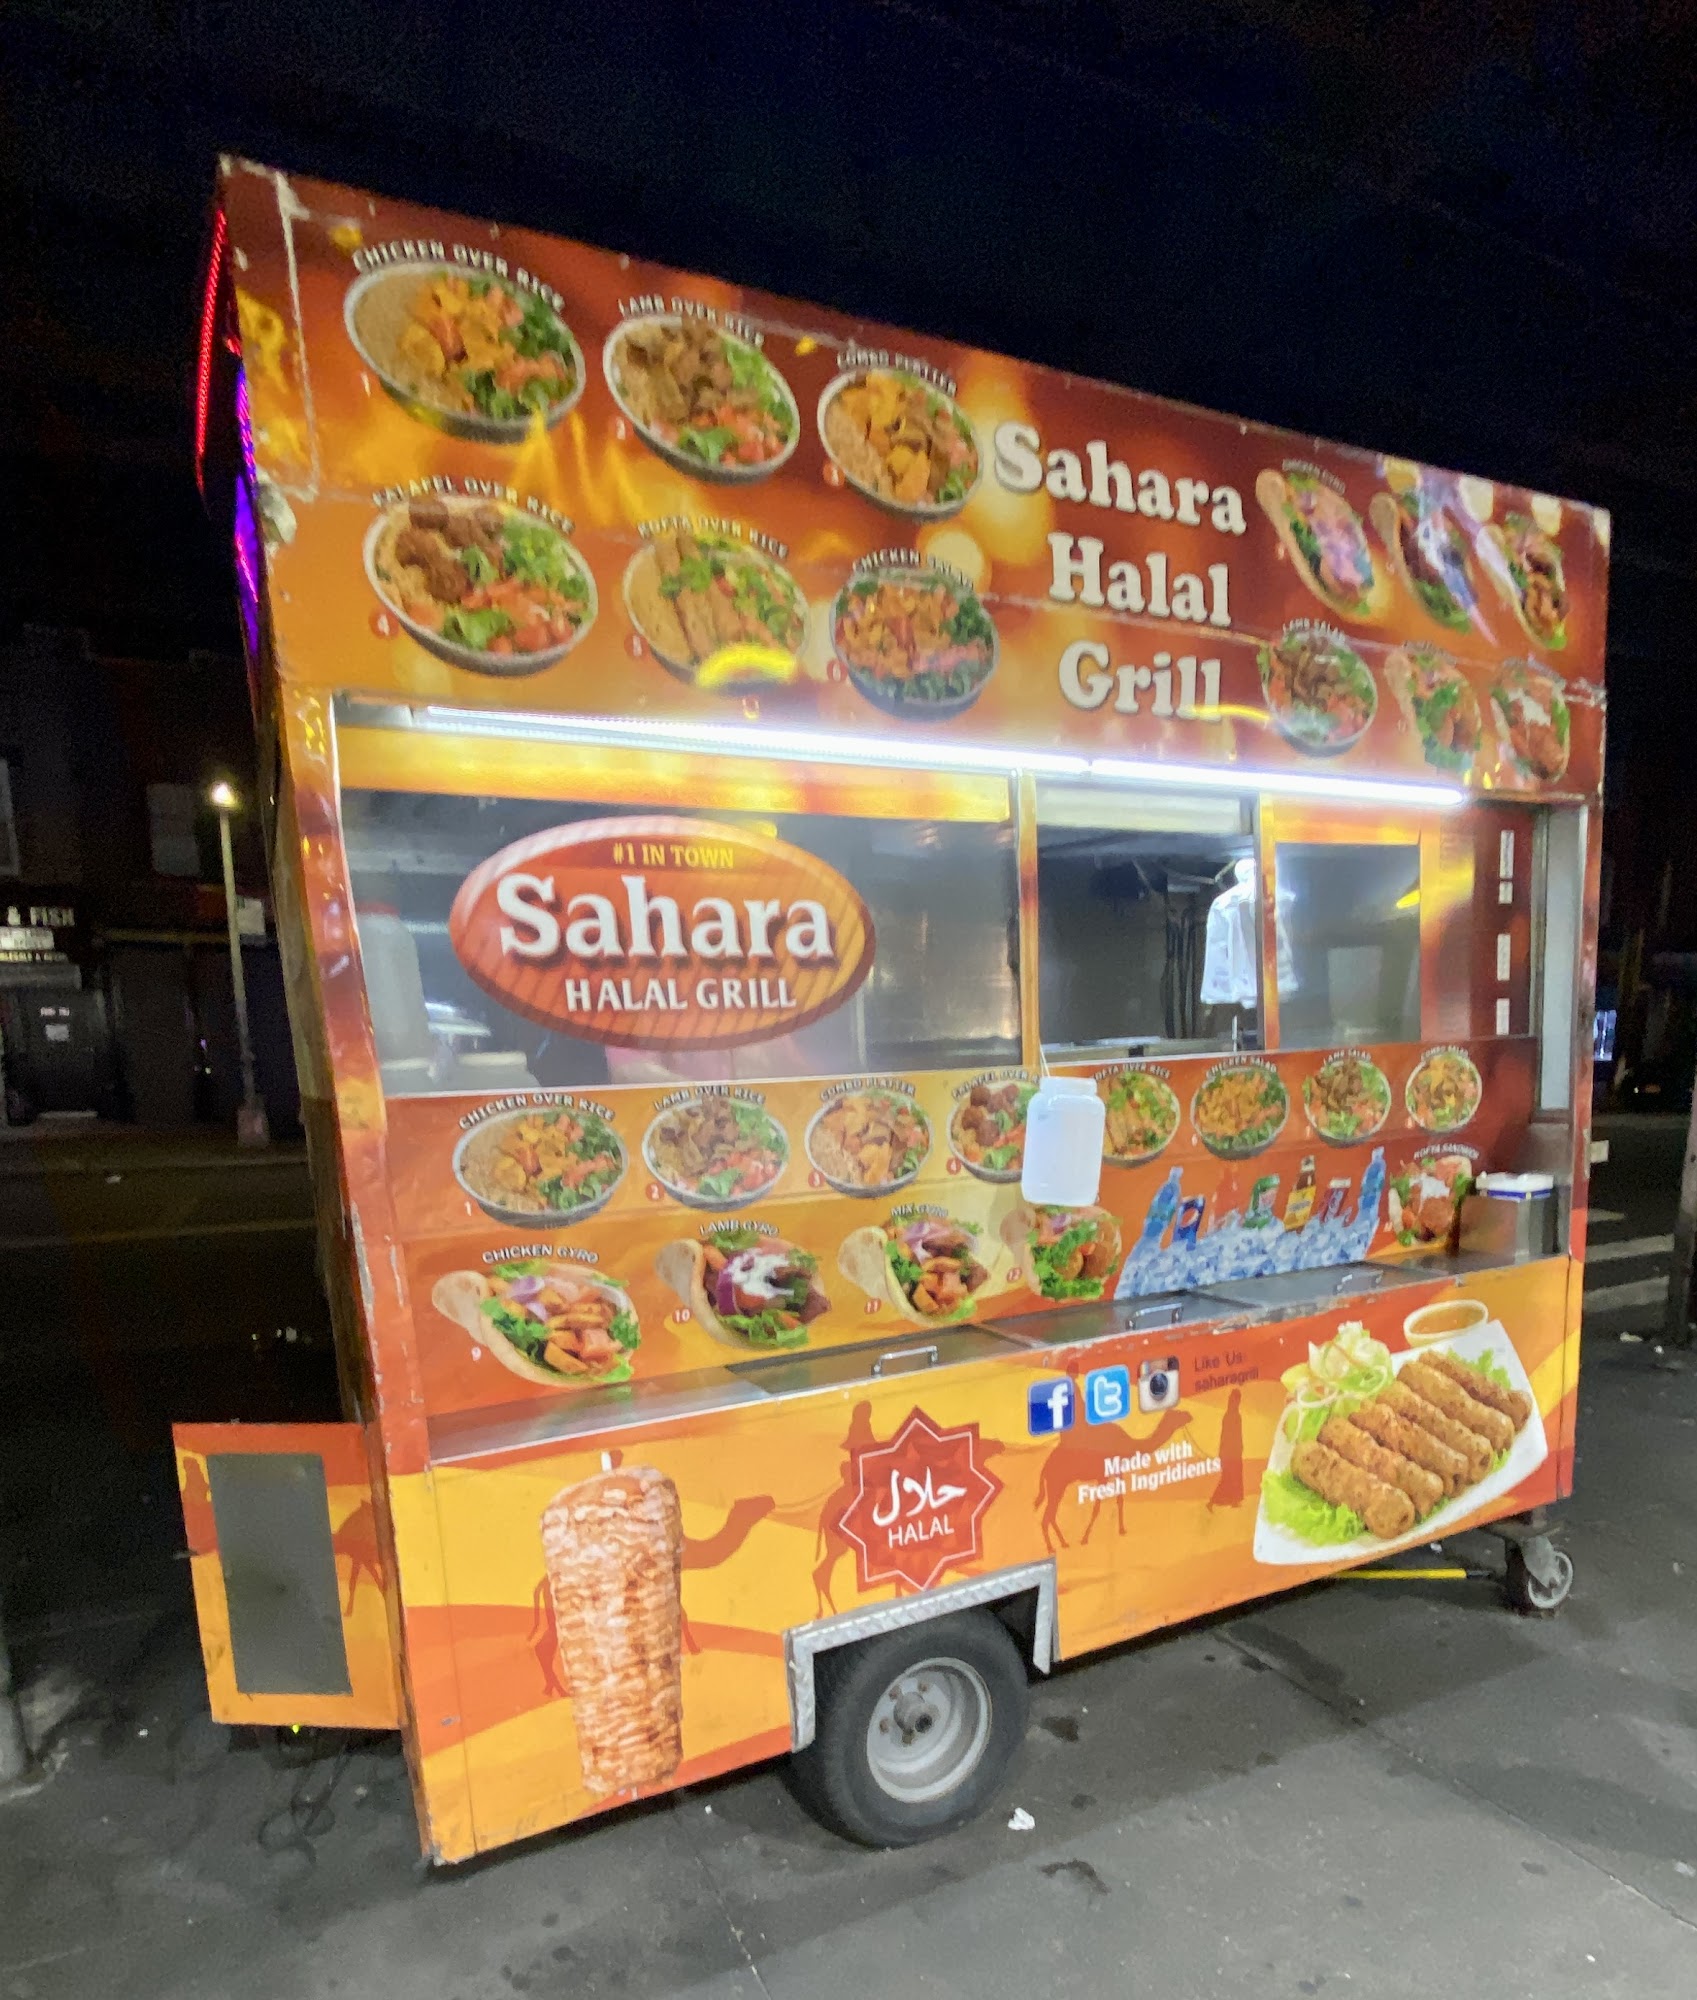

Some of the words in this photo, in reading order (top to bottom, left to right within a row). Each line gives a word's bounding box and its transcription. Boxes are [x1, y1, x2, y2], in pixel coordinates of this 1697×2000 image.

[353, 239, 445, 273] CHICKEN
[453, 243, 508, 277] OVER
[517, 267, 565, 313] RICE
[618, 293, 665, 317] LAMB
[671, 296, 717, 326] OVER
[725, 312, 765, 350] RICE
[994, 420, 1247, 536] Sahara
[372, 475, 452, 508] FALAFEL
[464, 477, 518, 503] OVER
[527, 496, 576, 535] RICE
[852, 548, 920, 574] CHICKEN
[1047, 531, 1232, 628] Halal
[1058, 640, 1222, 723] Grill
[612, 842, 636, 867] #1
[642, 844, 666, 867] IN
[670, 844, 735, 869] TOWN
[496, 873, 836, 959] Sahara
[564, 977, 688, 1012] HALAL
[696, 976, 797, 1010] GRILL
[1122, 1062, 1147, 1074] OVER
[1150, 1064, 1172, 1080] RICE
[1205, 1055, 1247, 1079] CHICKEN
[1250, 1056, 1278, 1073] SALAD
[653, 1090, 691, 1112] LAMB
[693, 1087, 731, 1099] OVER
[734, 1086, 767, 1105] RICE
[820, 1078, 863, 1101] COMBO
[866, 1076, 917, 1098] PLATTER
[458, 1093, 527, 1131] CHICKEN
[533, 1091, 575, 1109] OVER
[578, 1097, 617, 1122] RICE
[700, 1219, 740, 1236] LAMB
[742, 1219, 779, 1237] GYRO
[891, 1204, 915, 1218] MIX
[482, 1244, 553, 1264] CHICKEN
[557, 1246, 599, 1264] GYRO
[674, 1309, 691, 1321] 10
[1194, 1355, 1220, 1373] Like
[1104, 1450, 1151, 1478] Made
[1155, 1439, 1193, 1466] with
[872, 1466, 968, 1527] حلال
[1078, 1472, 1127, 1505] Fresh
[1130, 1456, 1222, 1492] Ingridients
[887, 1513, 955, 1549] HALAL
